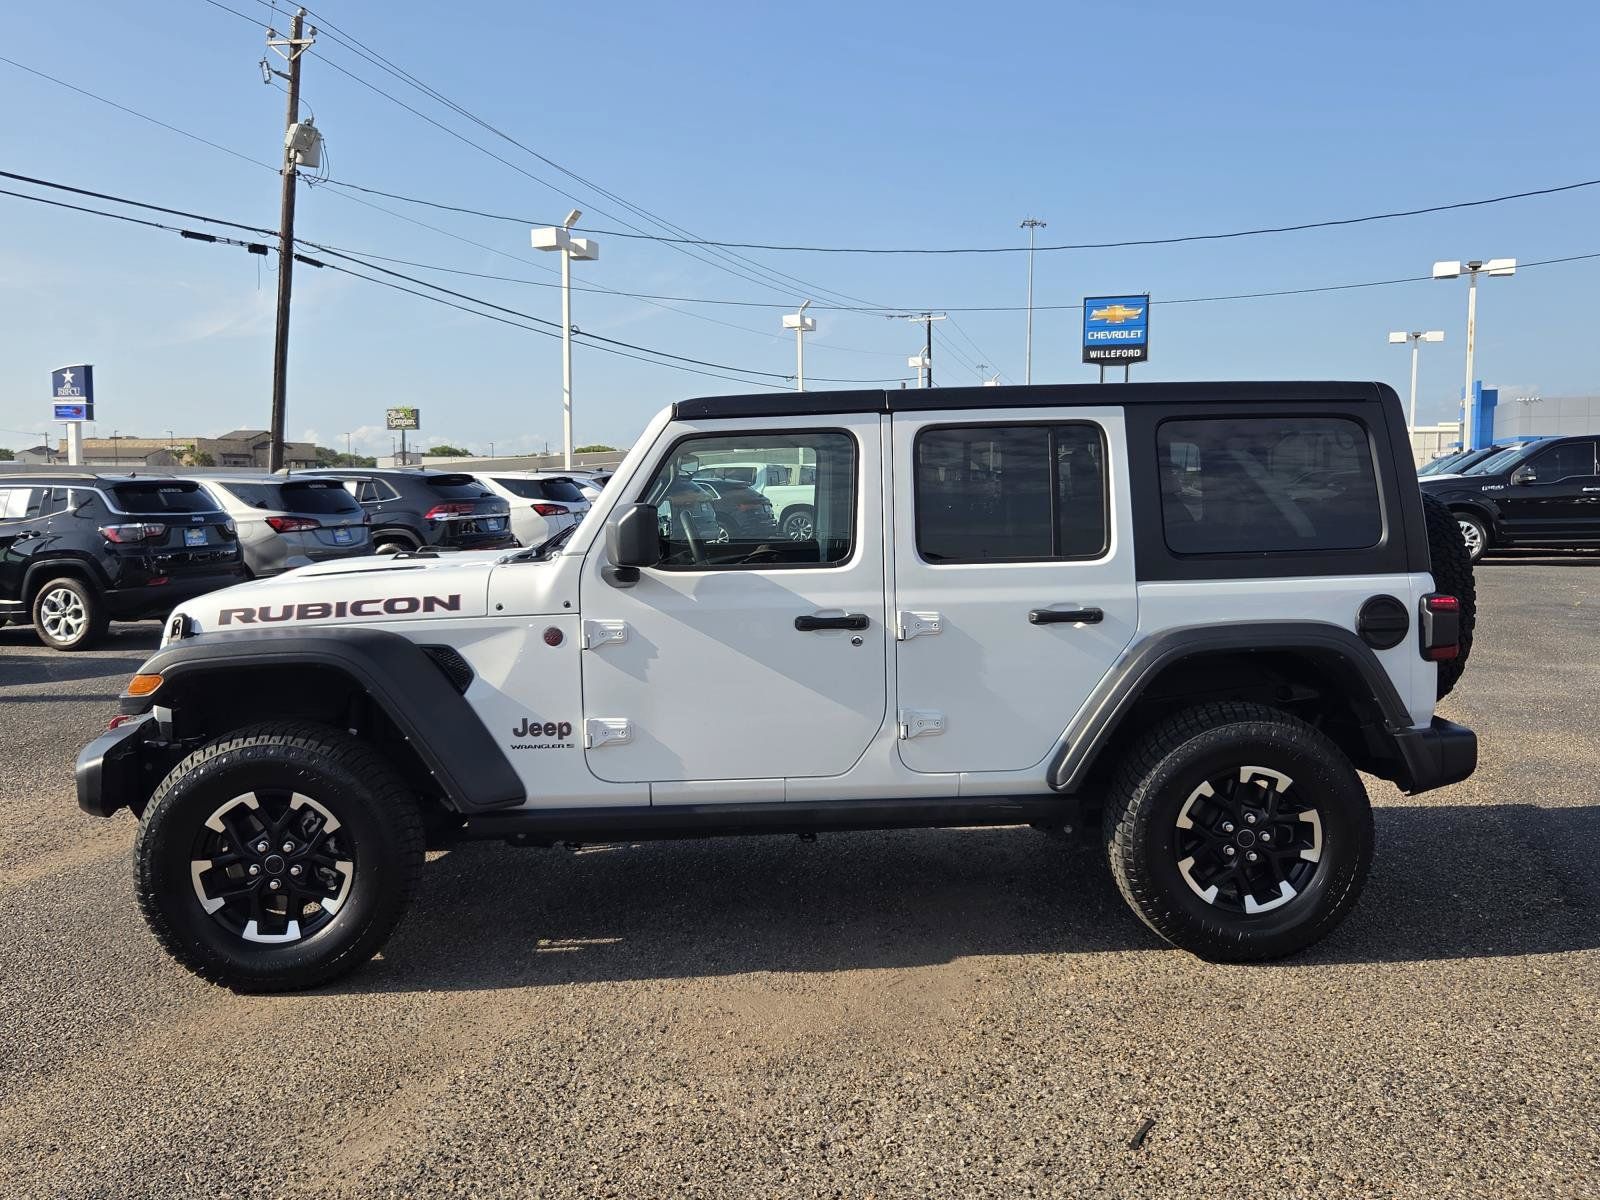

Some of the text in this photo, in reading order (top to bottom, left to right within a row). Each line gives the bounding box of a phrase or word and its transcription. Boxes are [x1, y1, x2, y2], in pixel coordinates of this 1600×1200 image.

[1088, 330, 1143, 340] CHEVROLET
[1089, 349, 1142, 359] WILLEFORD
[218, 594, 461, 625] RUBICON
[512, 717, 572, 741] Jeep
